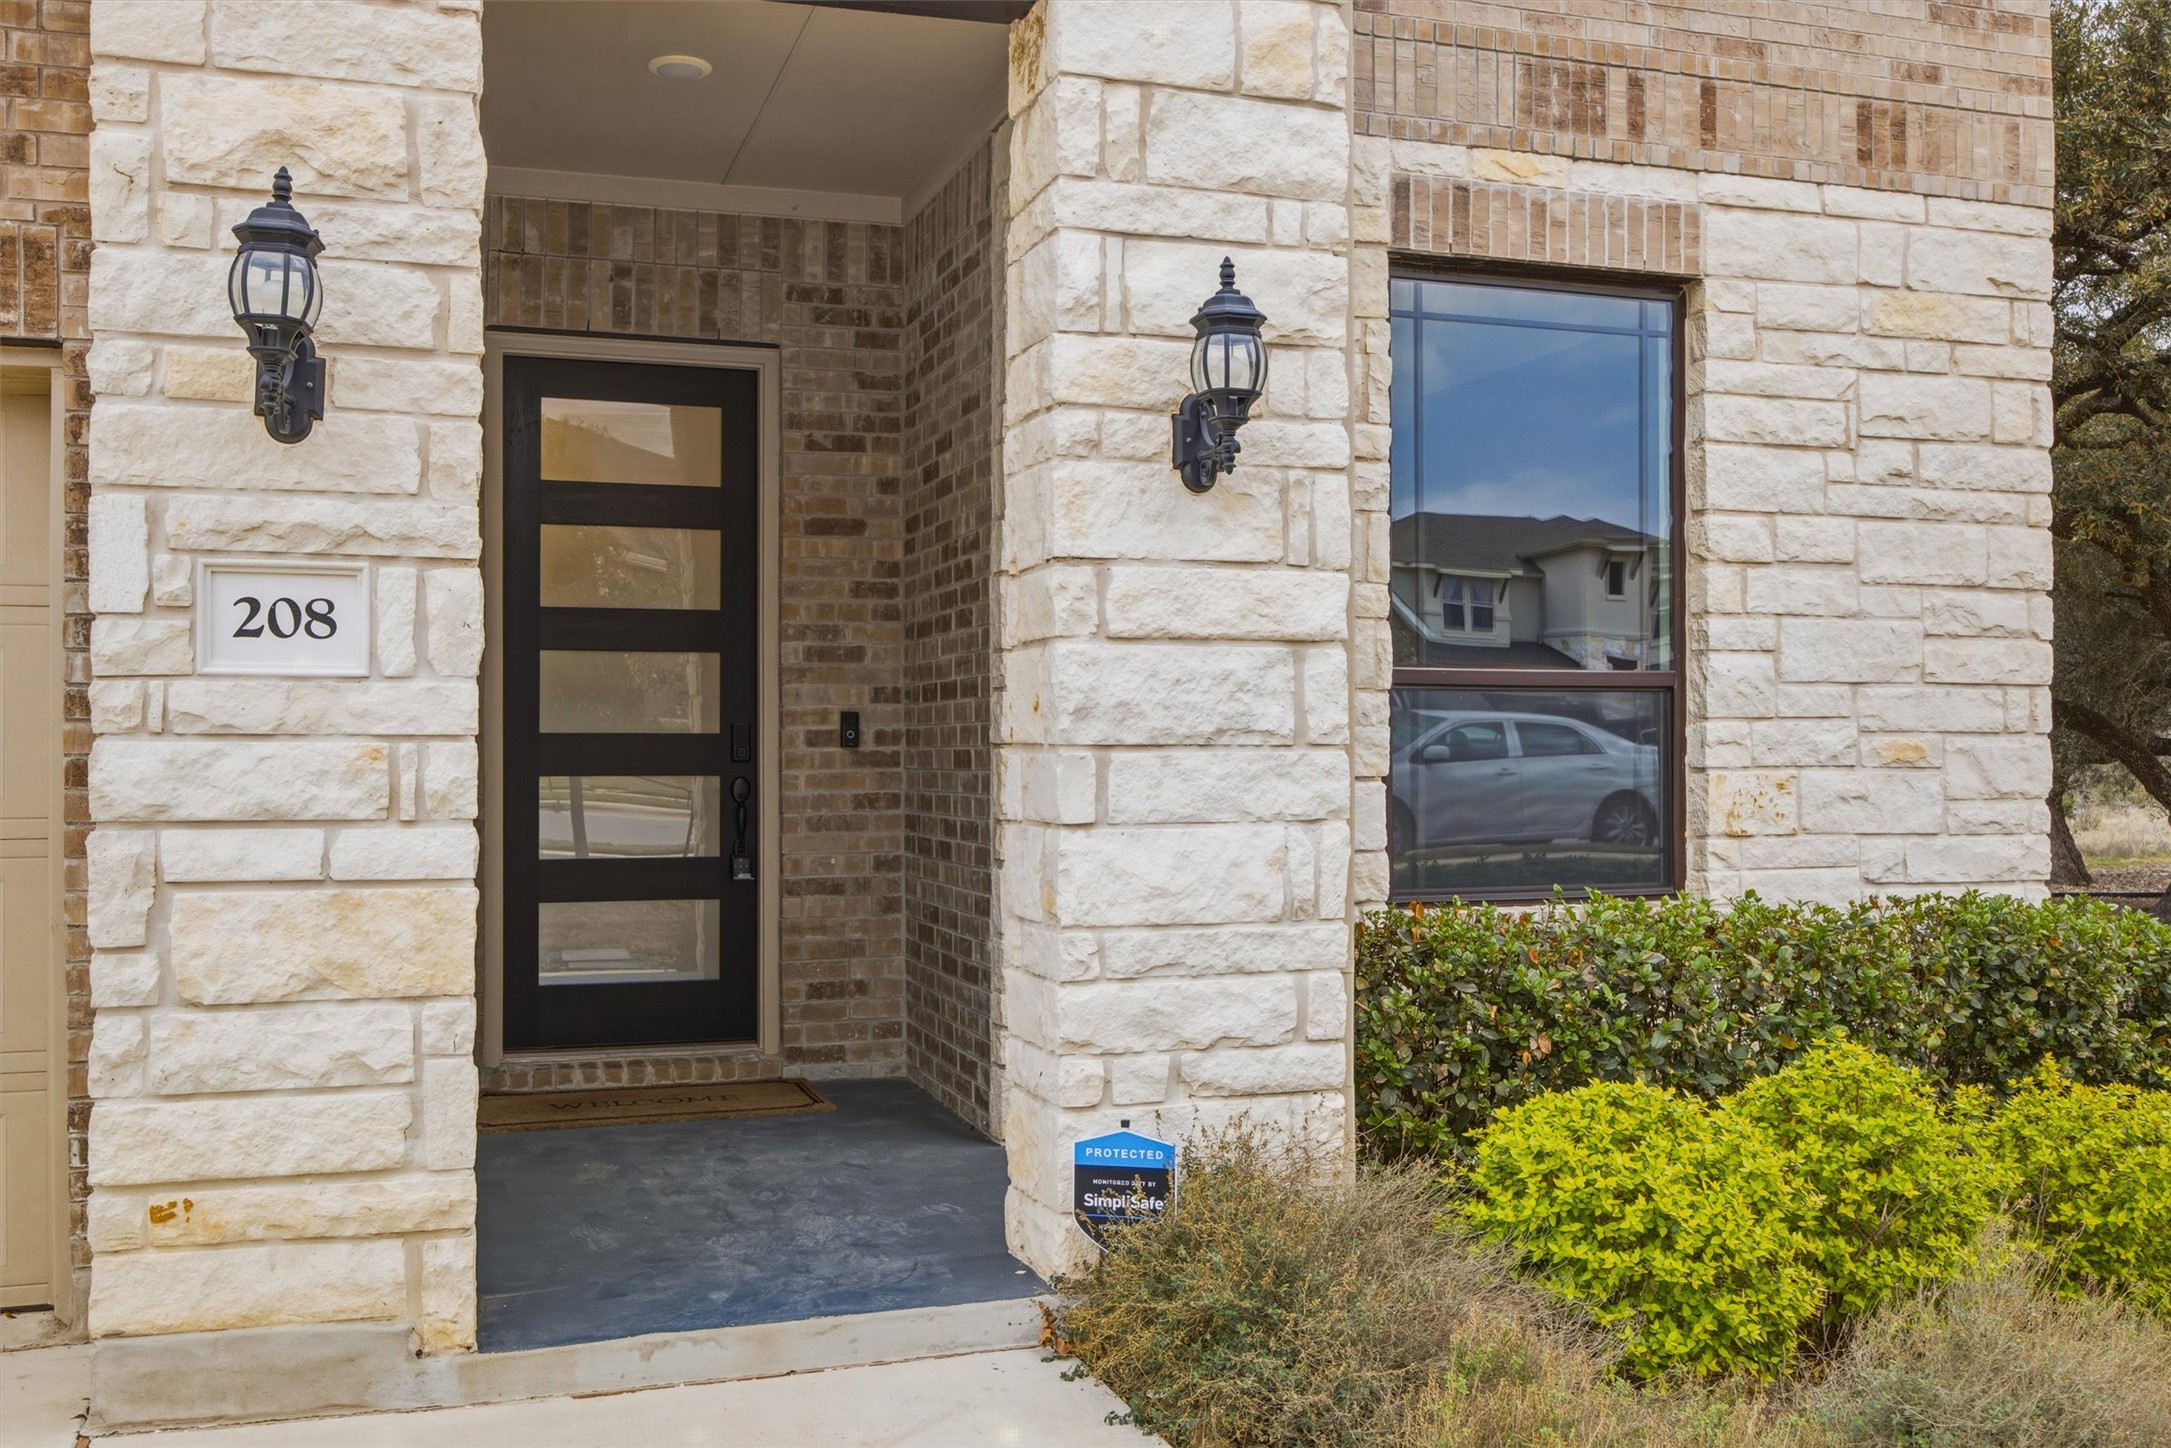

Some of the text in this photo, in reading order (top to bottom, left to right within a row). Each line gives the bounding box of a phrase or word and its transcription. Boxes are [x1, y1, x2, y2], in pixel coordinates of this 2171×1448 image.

[232, 596, 337, 639] 208
[549, 1094, 739, 1109] WELCOME
[1085, 1147, 1164, 1160] PROTECTED
[1092, 1178, 1130, 1187] MONITORED
